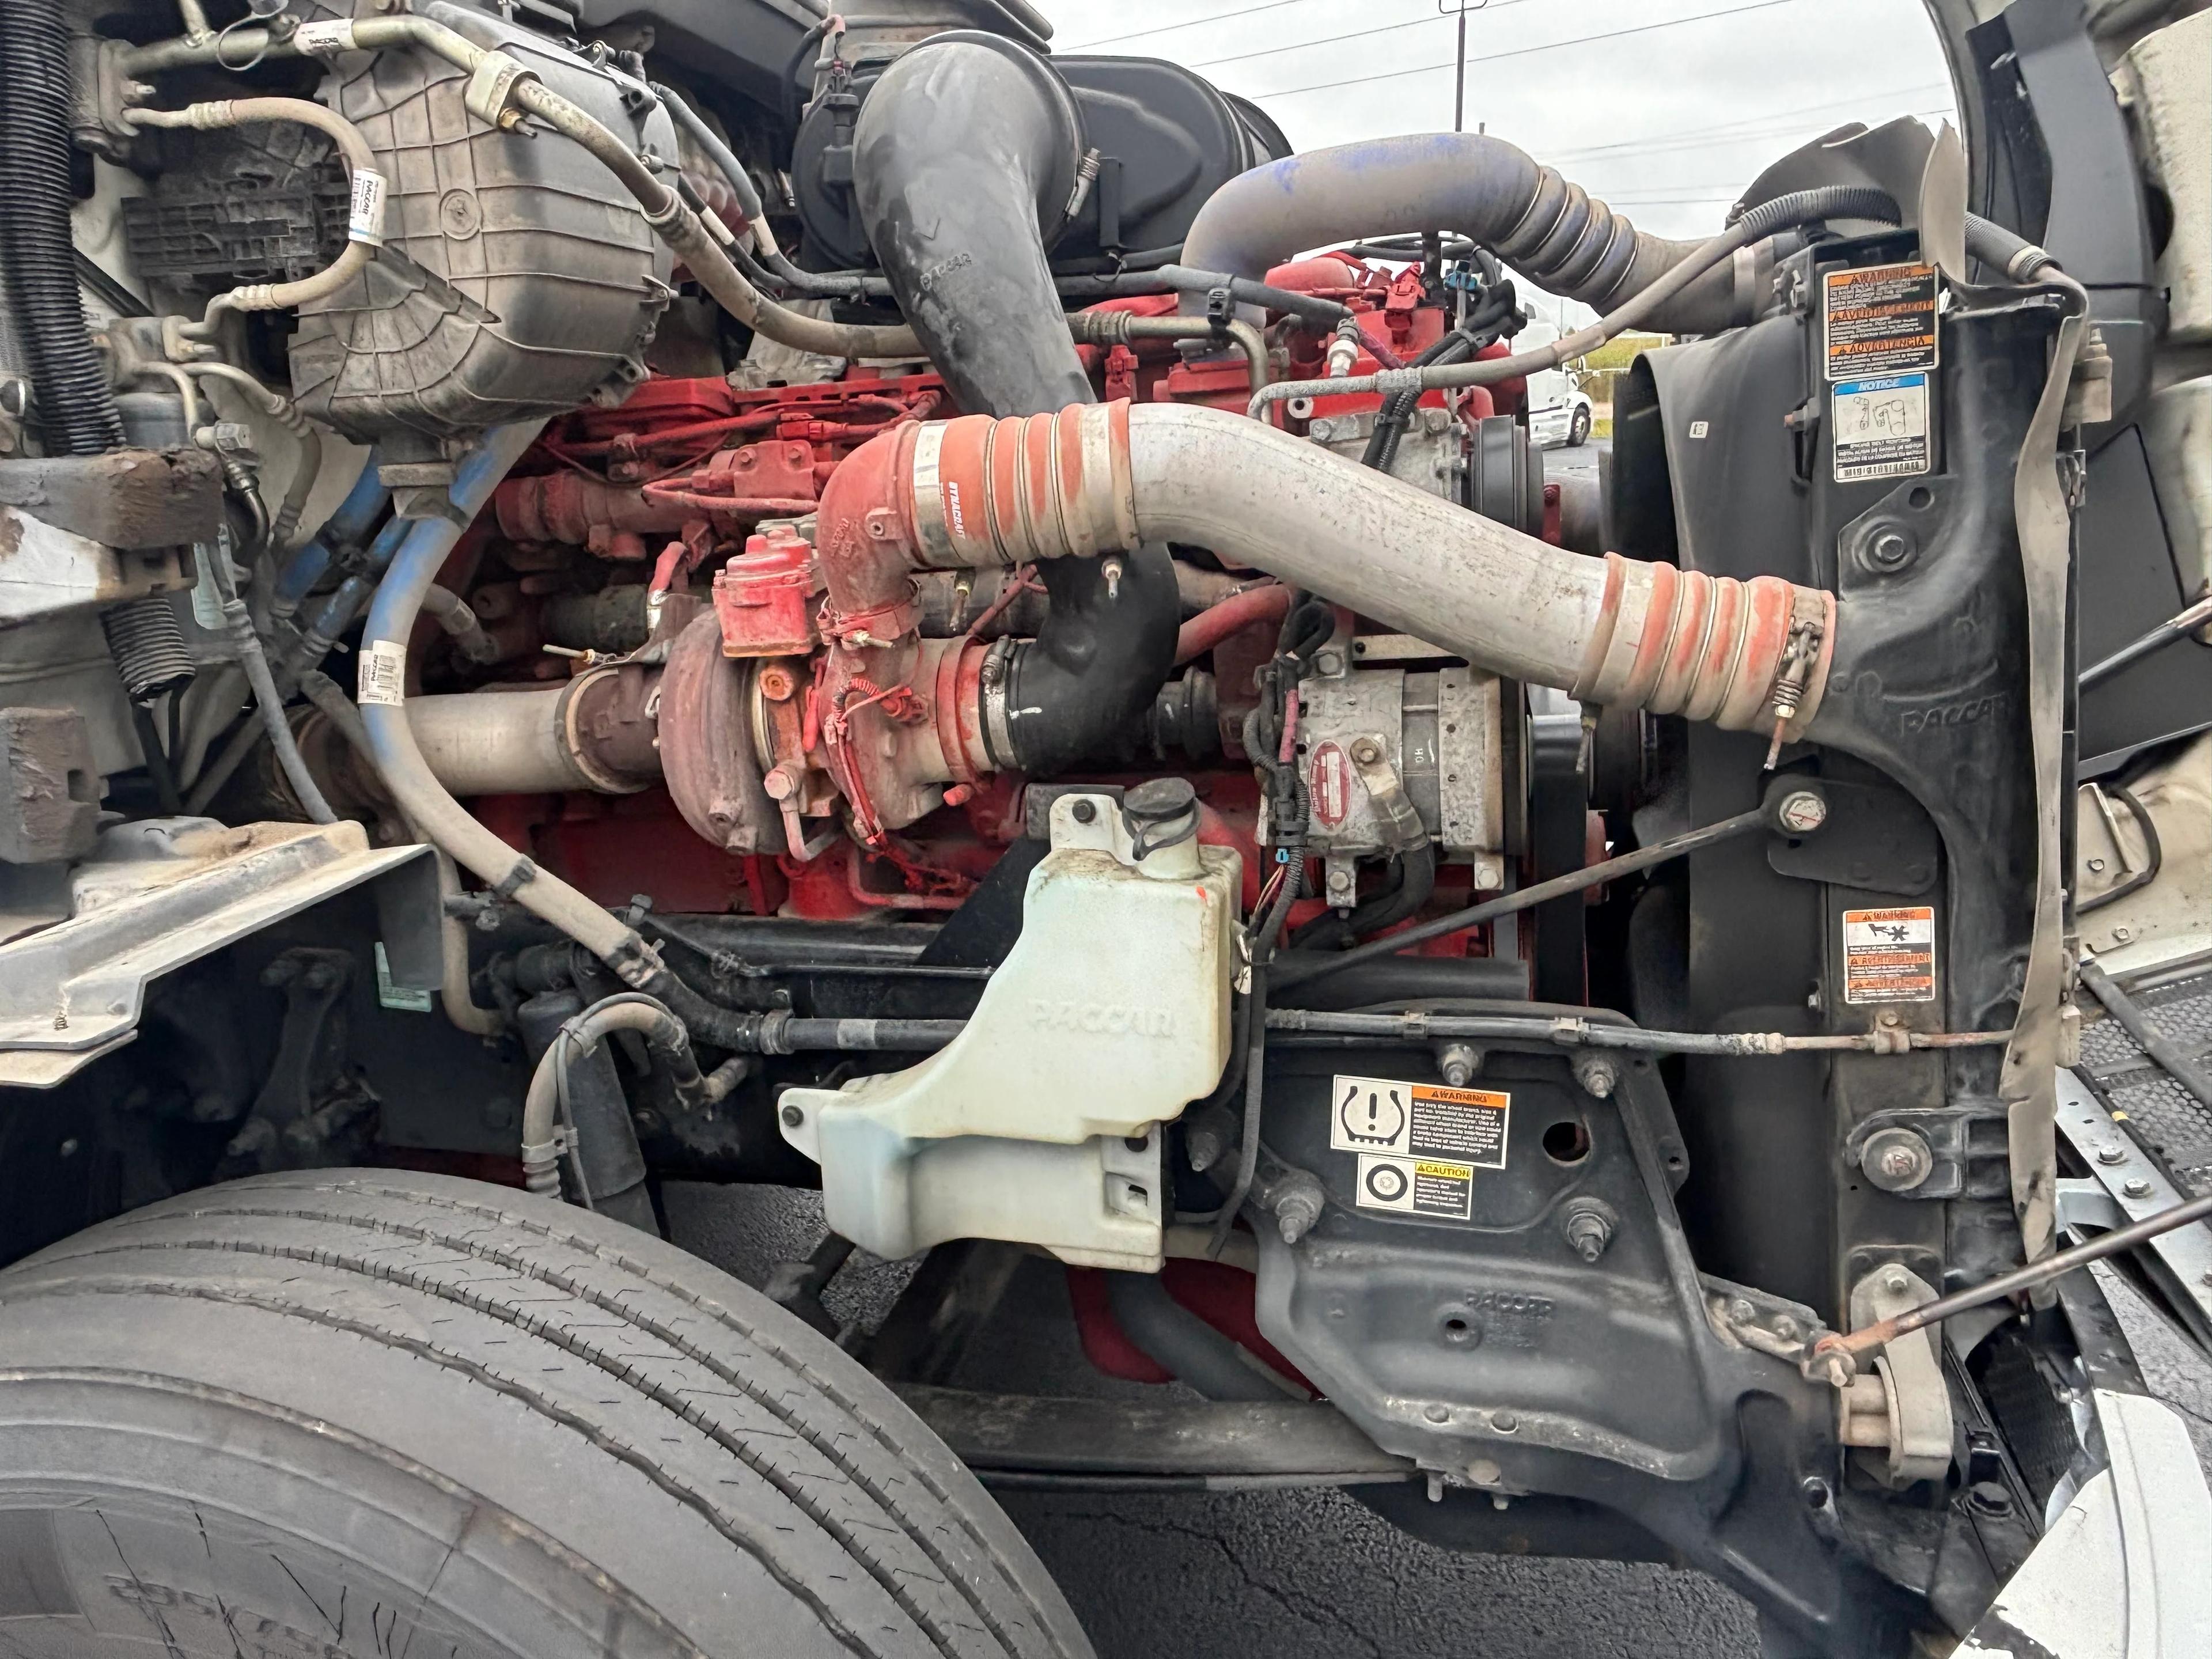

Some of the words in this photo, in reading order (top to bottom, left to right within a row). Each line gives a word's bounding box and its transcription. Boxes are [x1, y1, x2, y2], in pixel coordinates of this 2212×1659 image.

[362, 180, 373, 215] PACCAR
[1858, 378, 1901, 391] NOTICE
[1440, 1090, 1487, 1103] WARNING
[1426, 1165, 1470, 1177] CAUTION
